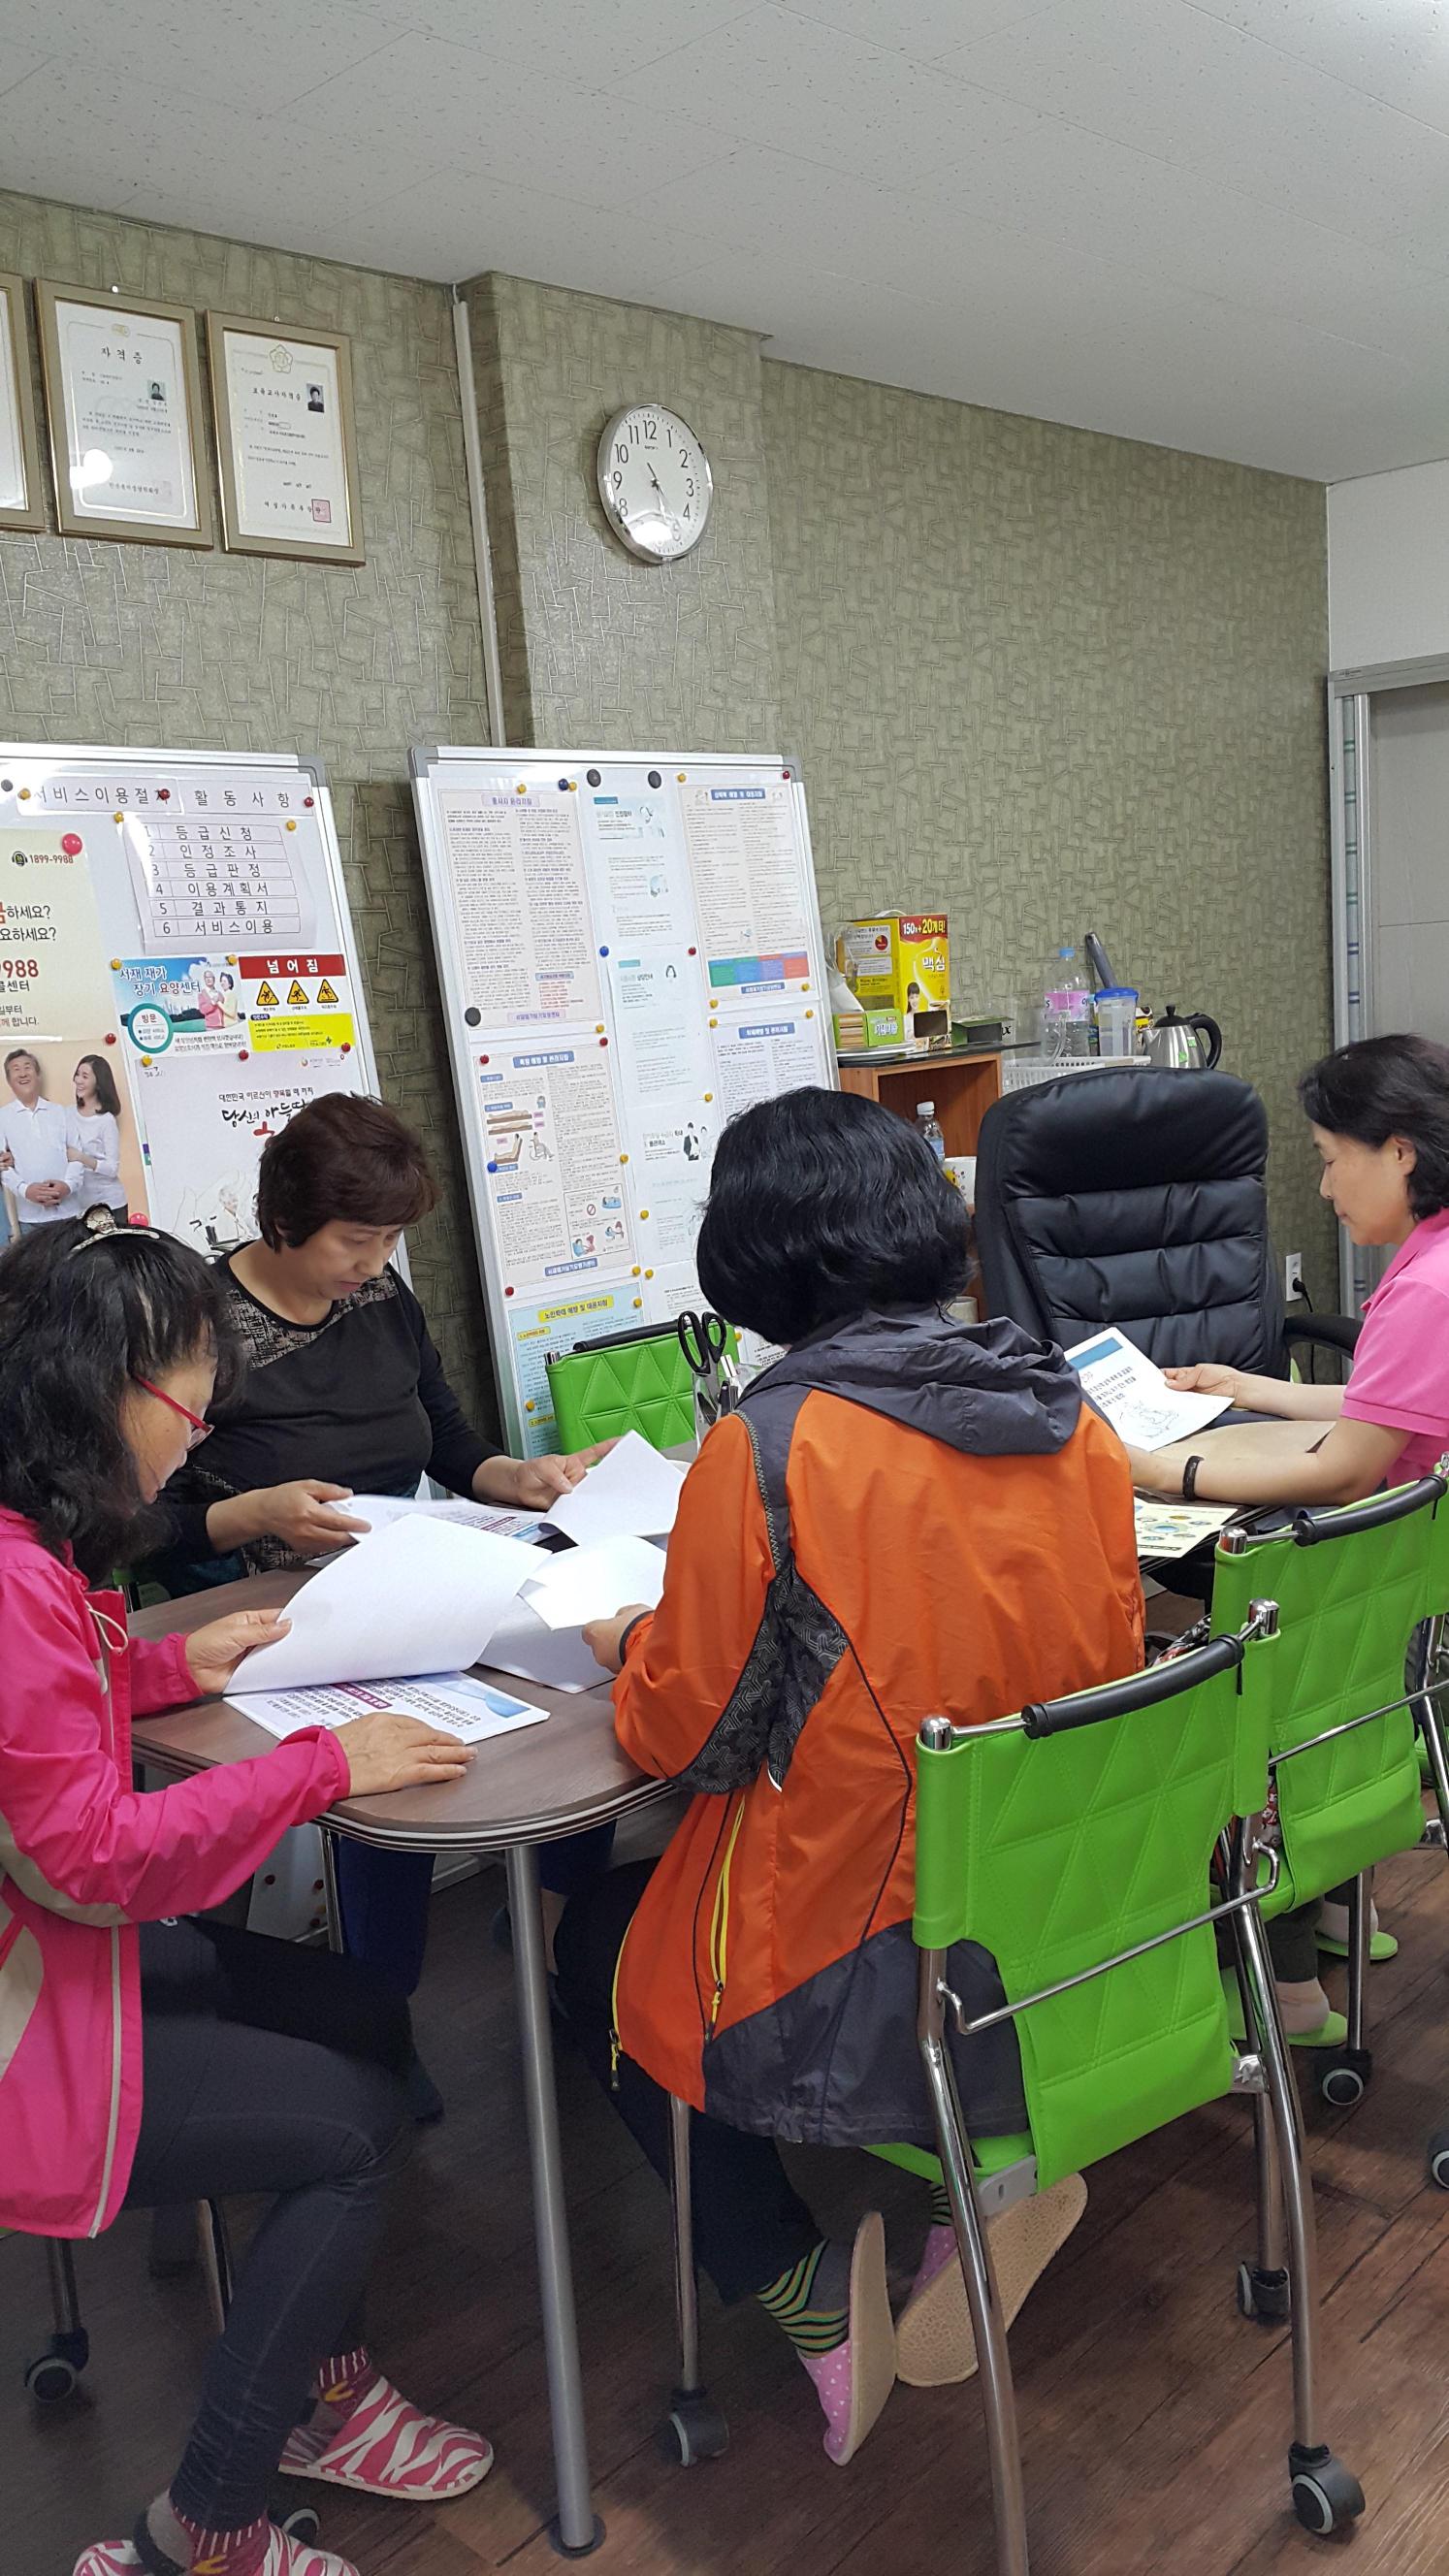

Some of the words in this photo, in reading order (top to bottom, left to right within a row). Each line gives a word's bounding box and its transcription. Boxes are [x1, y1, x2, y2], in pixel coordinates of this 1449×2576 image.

[101, 346, 143, 365] 자격증
[628, 425, 639, 444] 11
[643, 420, 657, 440] 12
[666, 429, 672, 448] 1
[615, 443, 629, 464] 10
[679, 449, 690, 468] 2
[613, 470, 623, 490] 9
[686, 478, 694, 497] 3
[619, 498, 628, 517] 8
[683, 502, 691, 521] 4
[194, 789, 290, 808] 활동사항
[145, 825, 151, 837] 1
[176, 825, 252, 841] 등급신청
[29, 853, 74, 864] 1899-9988
[148, 845, 155, 856] 2
[179, 845, 256, 859] 인정조사
[151, 864, 159, 876] 3
[184, 863, 260, 878] 등급판정
[156, 884, 163, 894] 4
[188, 882, 269, 897] 이용계획서
[159, 902, 167, 915] 5
[192, 901, 268, 916] 결과통지
[163, 921, 171, 934] 6
[195, 918, 273, 935] 서비스이용
[0, 959, 39, 978] 988
[267, 958, 318, 974] 넘어짐
[922, 954, 946, 972] 맥심
[219, 1093, 244, 1103] 대한민국
